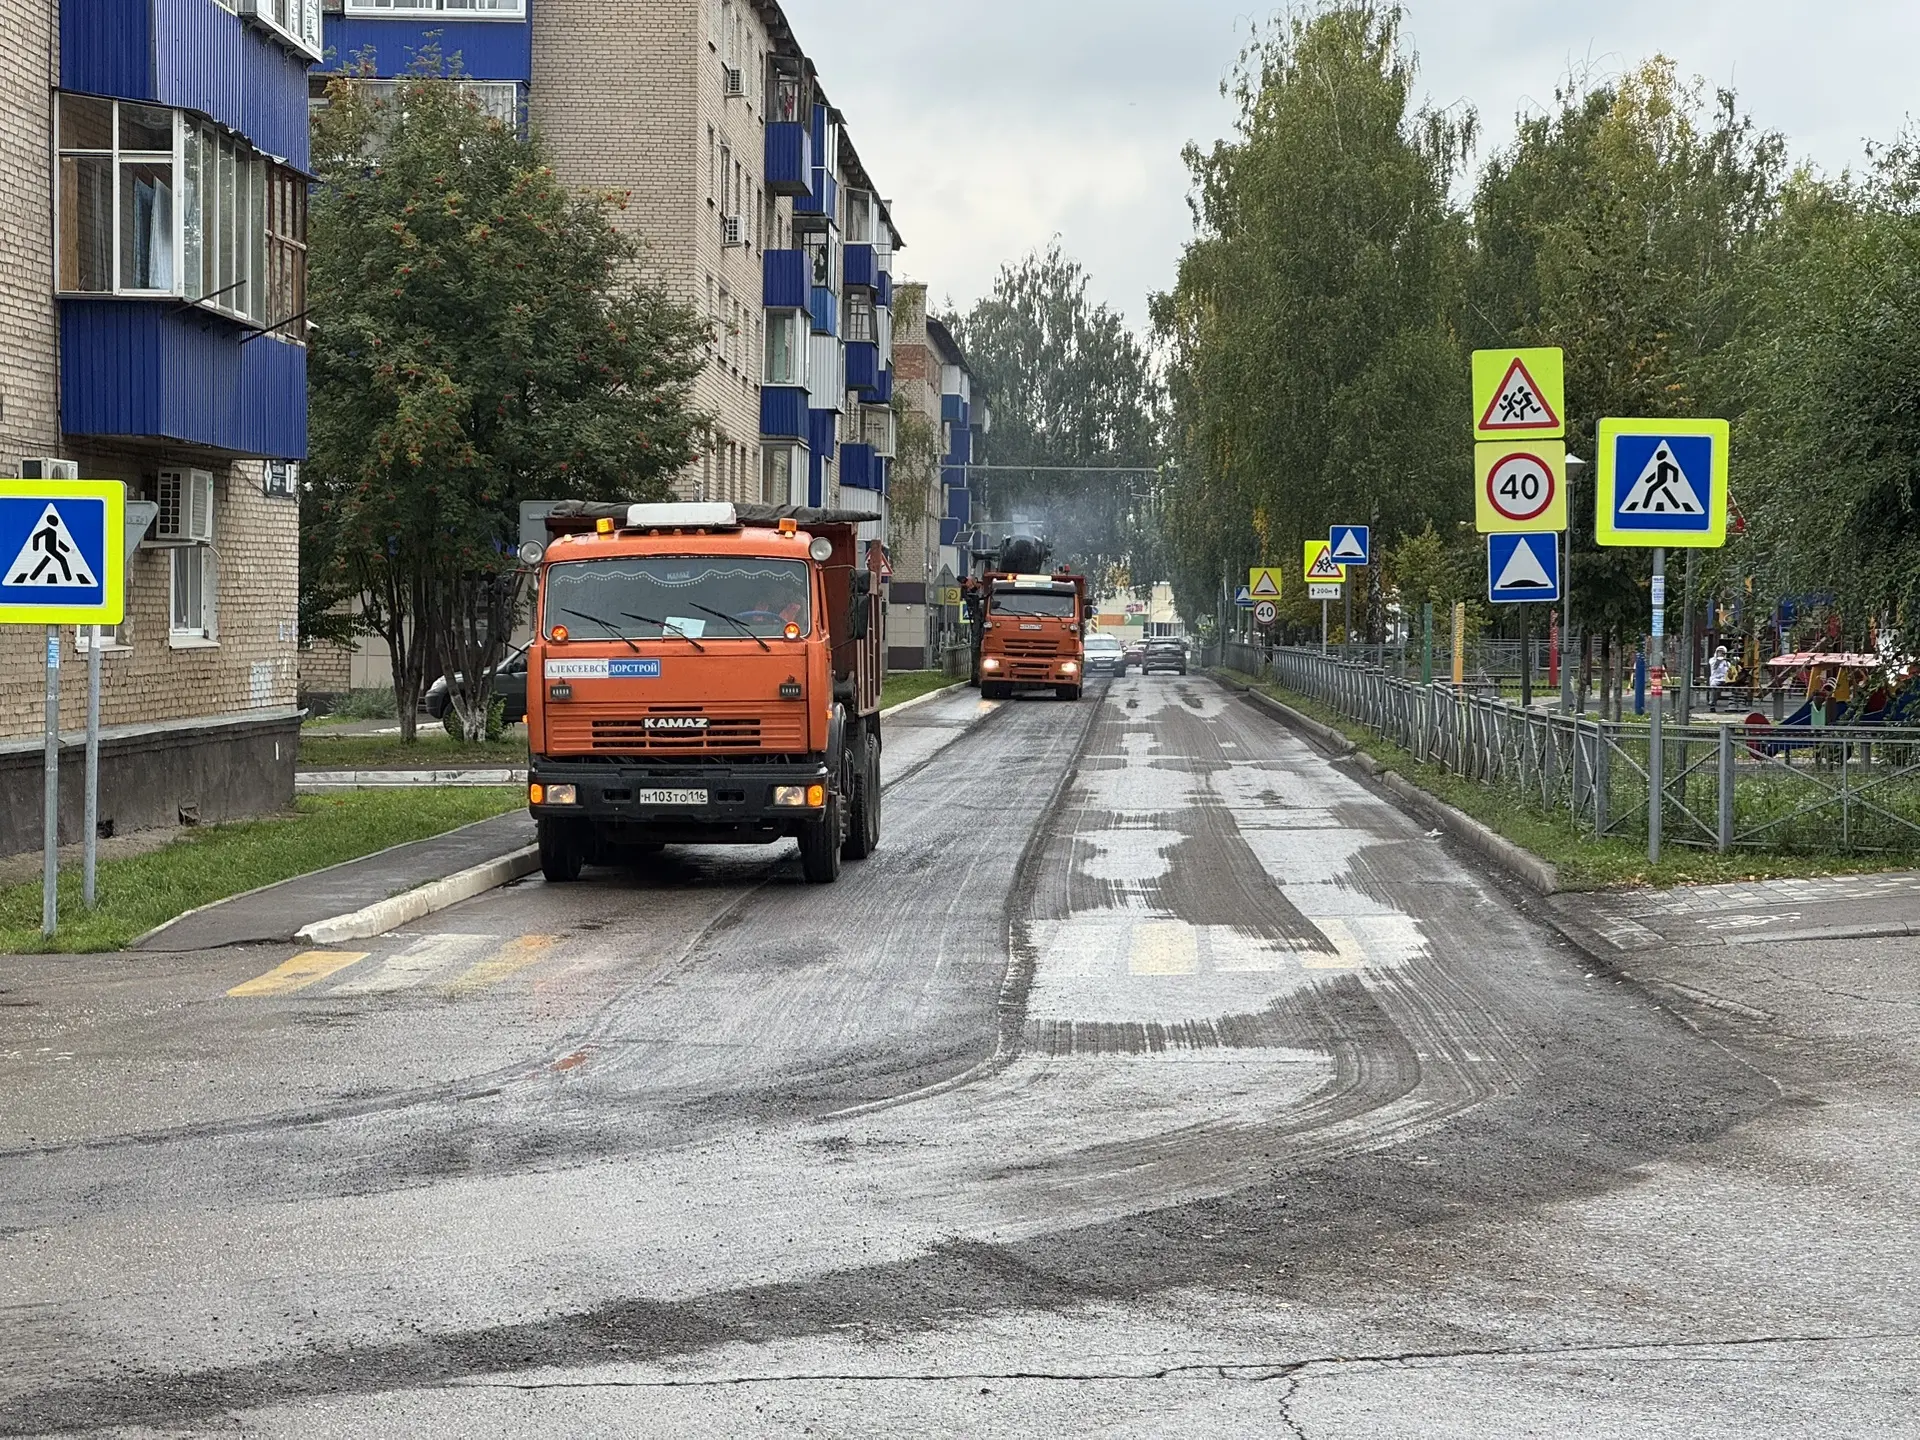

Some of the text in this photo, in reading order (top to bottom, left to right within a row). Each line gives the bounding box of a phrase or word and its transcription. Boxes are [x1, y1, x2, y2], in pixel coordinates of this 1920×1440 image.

[1499, 473, 1540, 500] 40
[1257, 606, 1274, 618] 40
[644, 718, 708, 728] KAMAZ
